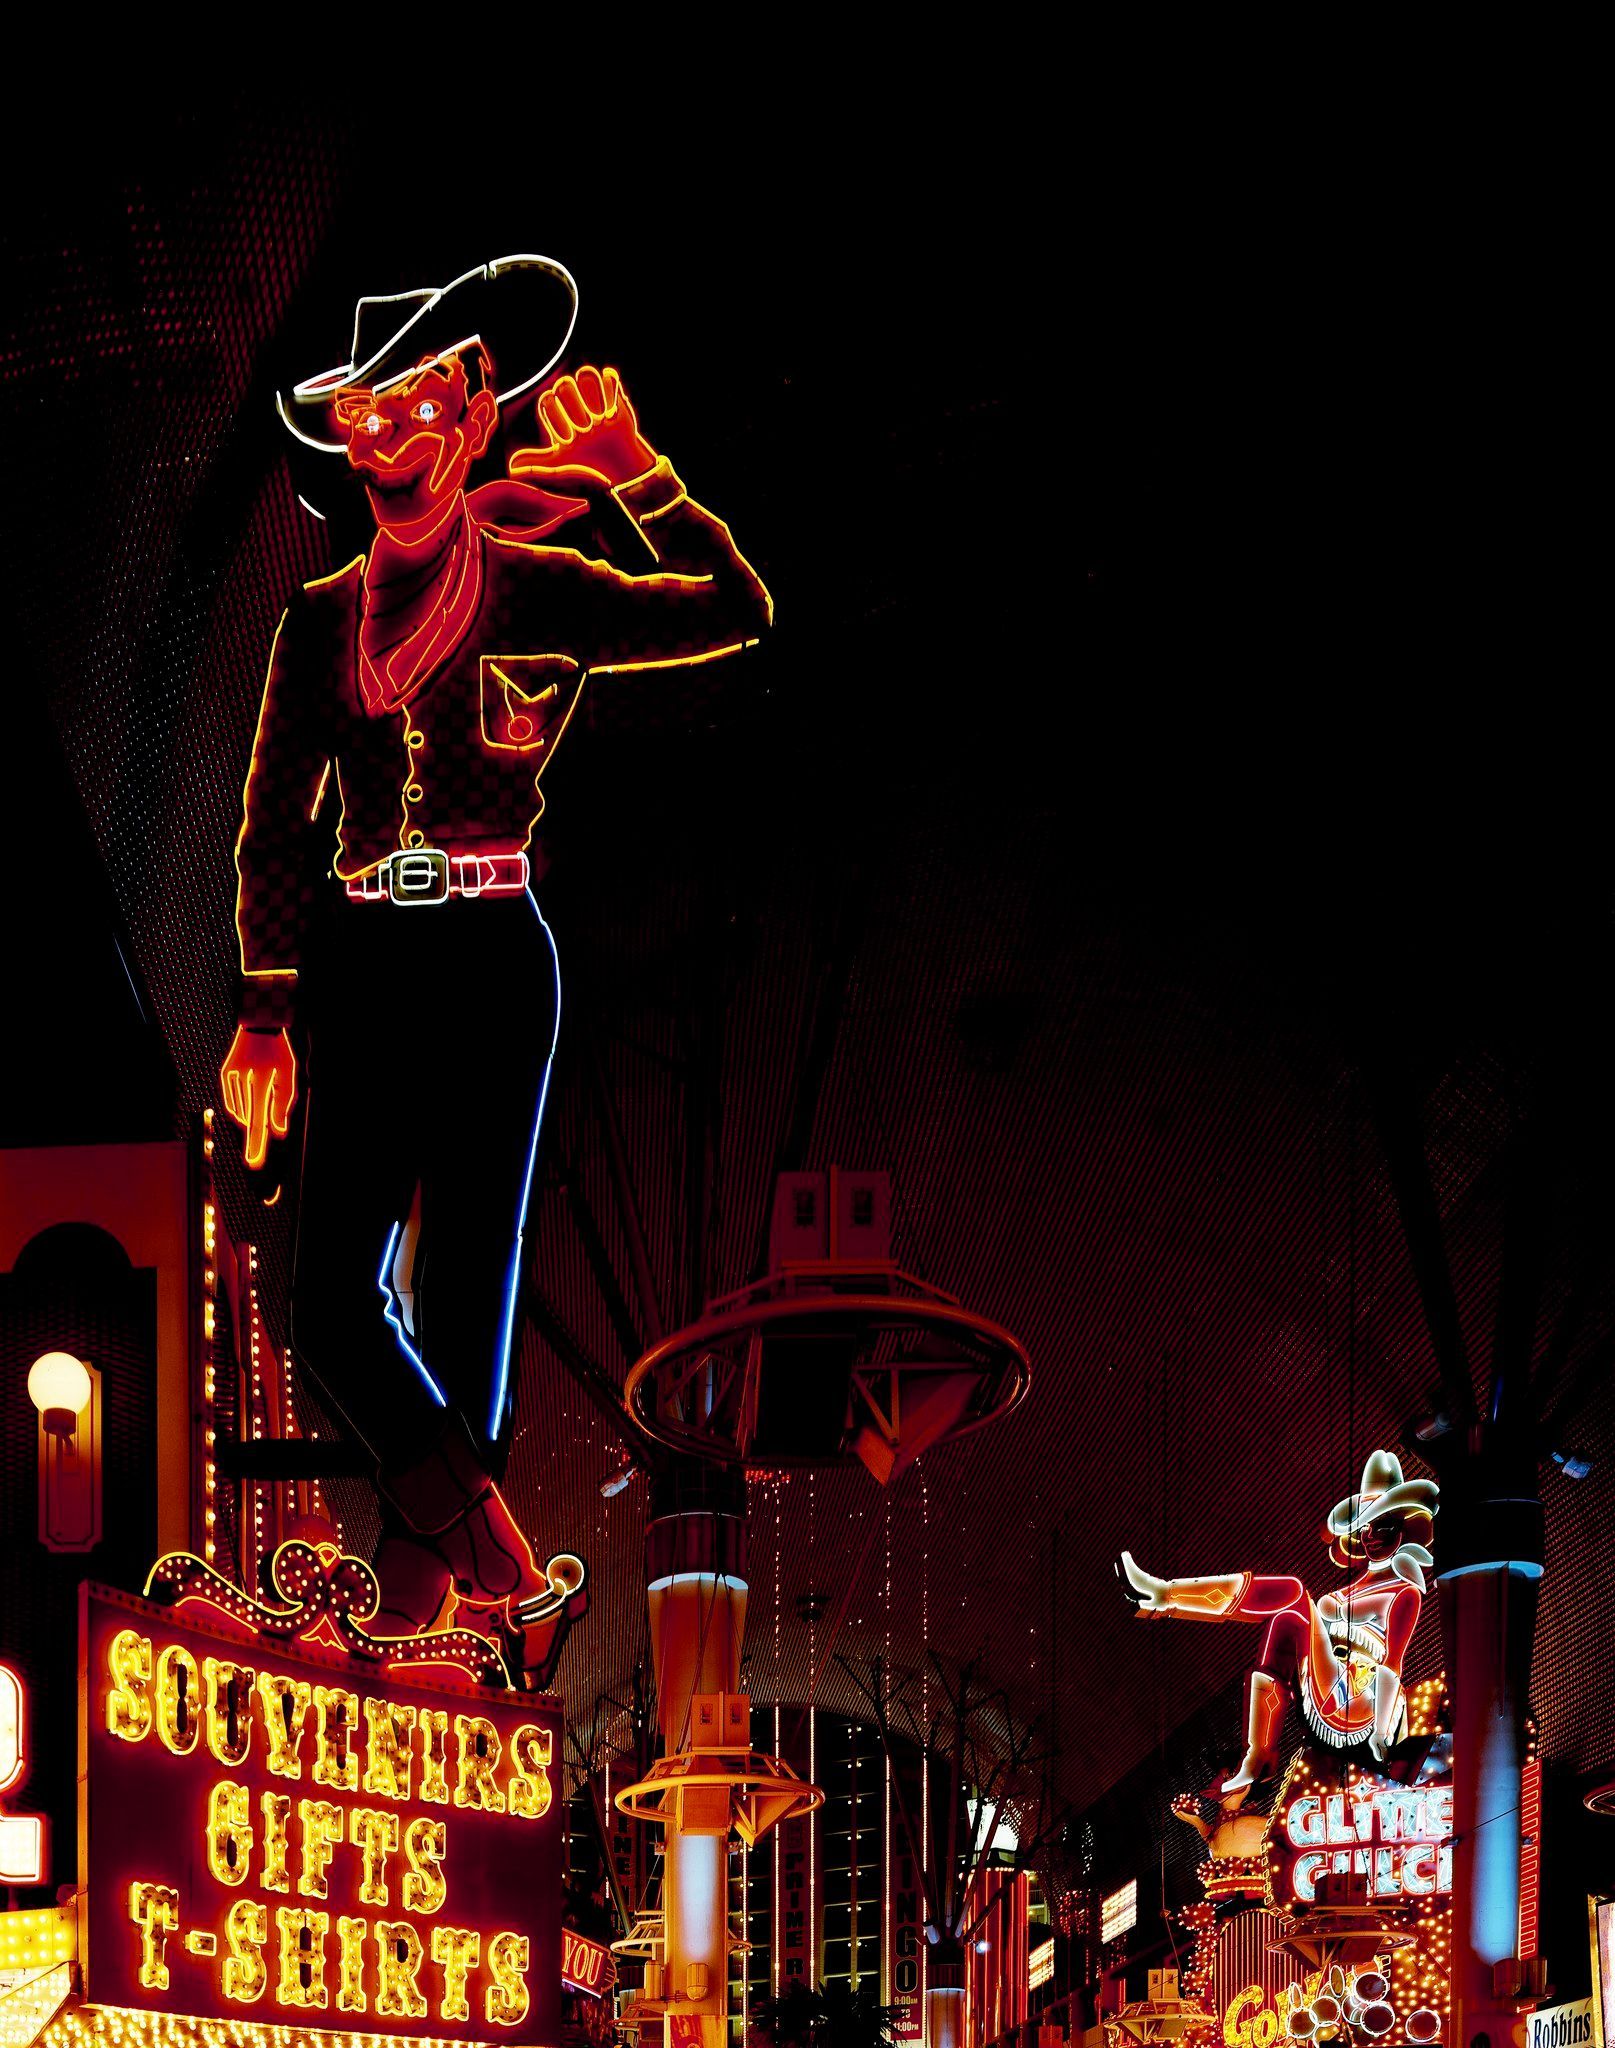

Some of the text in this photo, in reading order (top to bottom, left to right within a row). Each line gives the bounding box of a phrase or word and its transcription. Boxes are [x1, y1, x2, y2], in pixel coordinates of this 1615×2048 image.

[106, 1629, 553, 1819] SOUVENIRS
[206, 1780, 446, 1914] GIFTS
[1287, 1778, 1453, 1847] GLITTE
[129, 1881, 530, 2026] T-SHIRTS
[562, 1935, 603, 1986] YOU
[1534, 2008, 1591, 2048] Robbins
